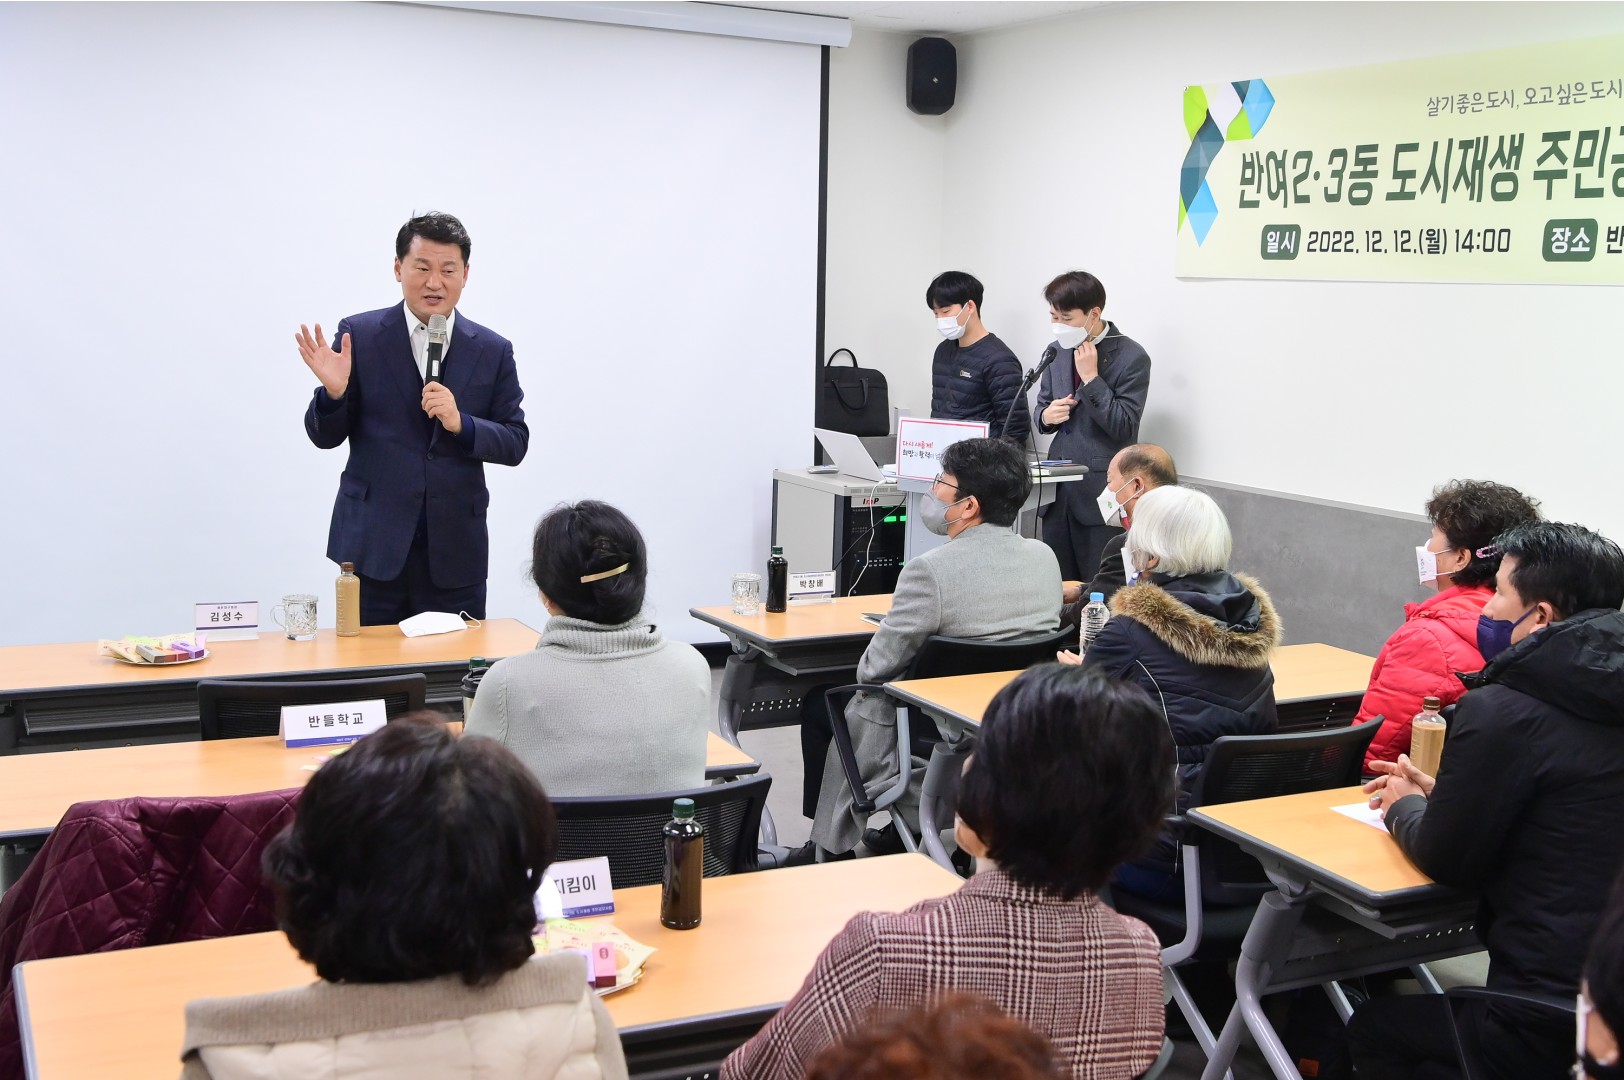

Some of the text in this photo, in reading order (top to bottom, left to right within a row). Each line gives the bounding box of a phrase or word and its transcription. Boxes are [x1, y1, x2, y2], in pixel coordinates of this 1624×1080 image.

[1427, 78, 1623, 117] 살기 좋은 도시, 오고 싶은 도시
[1385, 133, 1525, 204] 도시재생
[1266, 231, 1296, 253] 일시
[1307, 231, 1359, 253] 2022.
[1366, 230, 1387, 253] 12.
[1455, 228, 1511, 253] 14:00
[1551, 227, 1590, 254] 장소
[210, 611, 243, 622] 김성수
[308, 712, 364, 728] 반들학교
